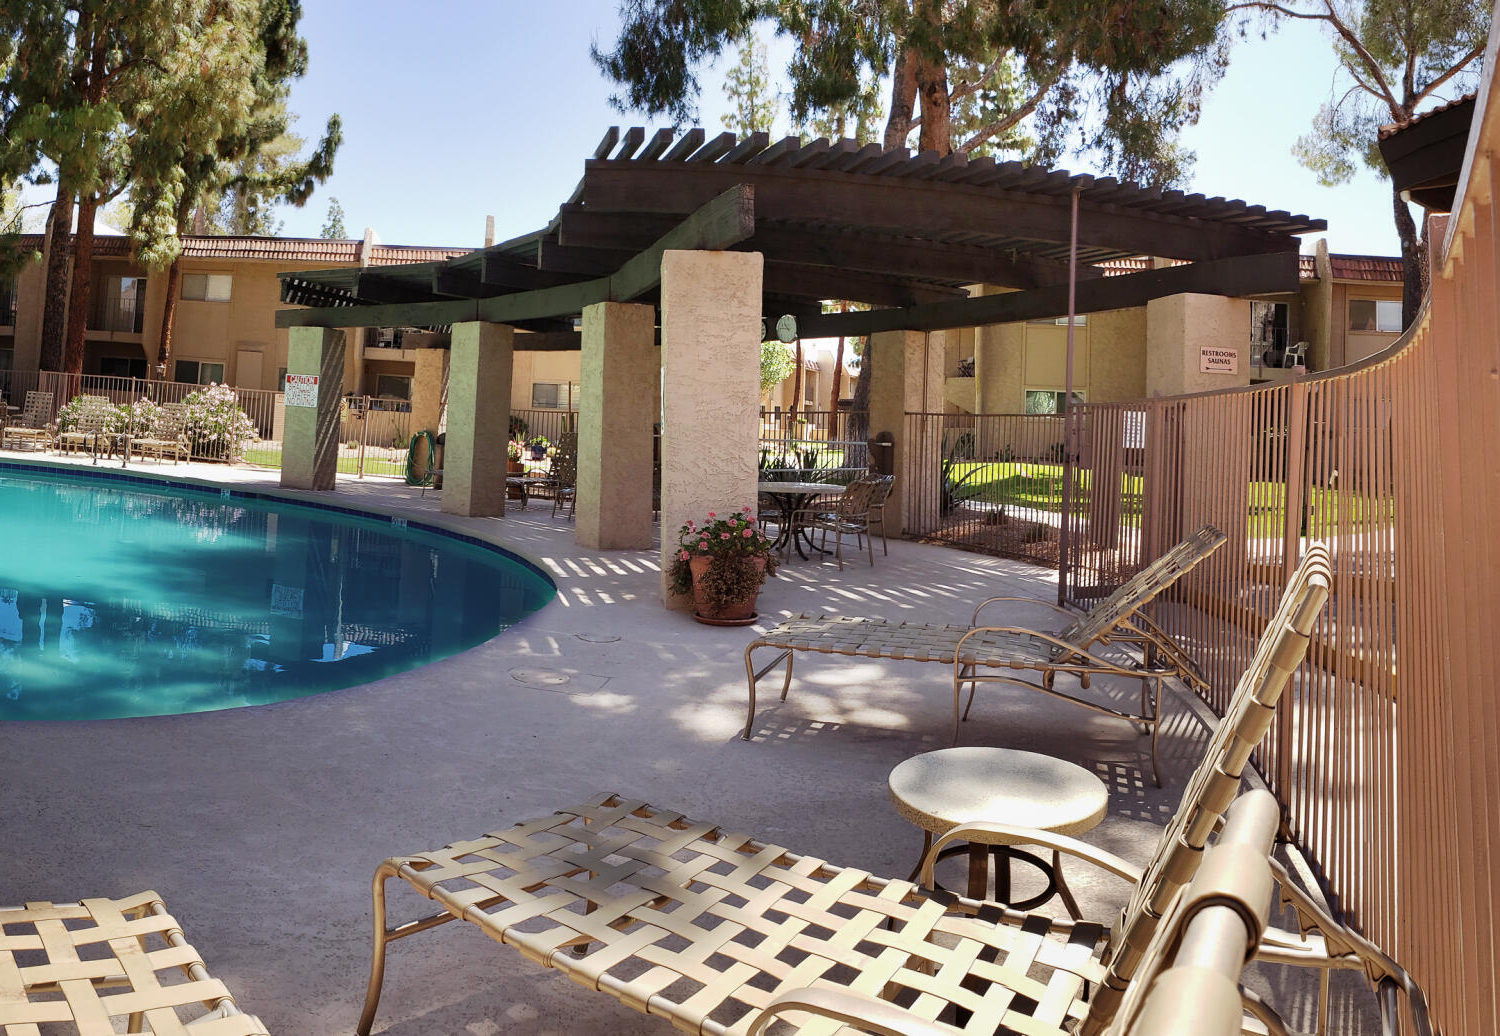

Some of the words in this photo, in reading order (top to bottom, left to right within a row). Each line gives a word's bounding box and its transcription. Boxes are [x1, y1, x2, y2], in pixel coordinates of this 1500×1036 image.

[1202, 350, 1237, 358] RESTROOMS
[290, 375, 315, 384] CAUTION
[292, 390, 311, 399] WATER
[287, 397, 296, 405] NO
[296, 398, 315, 406] DIVING
